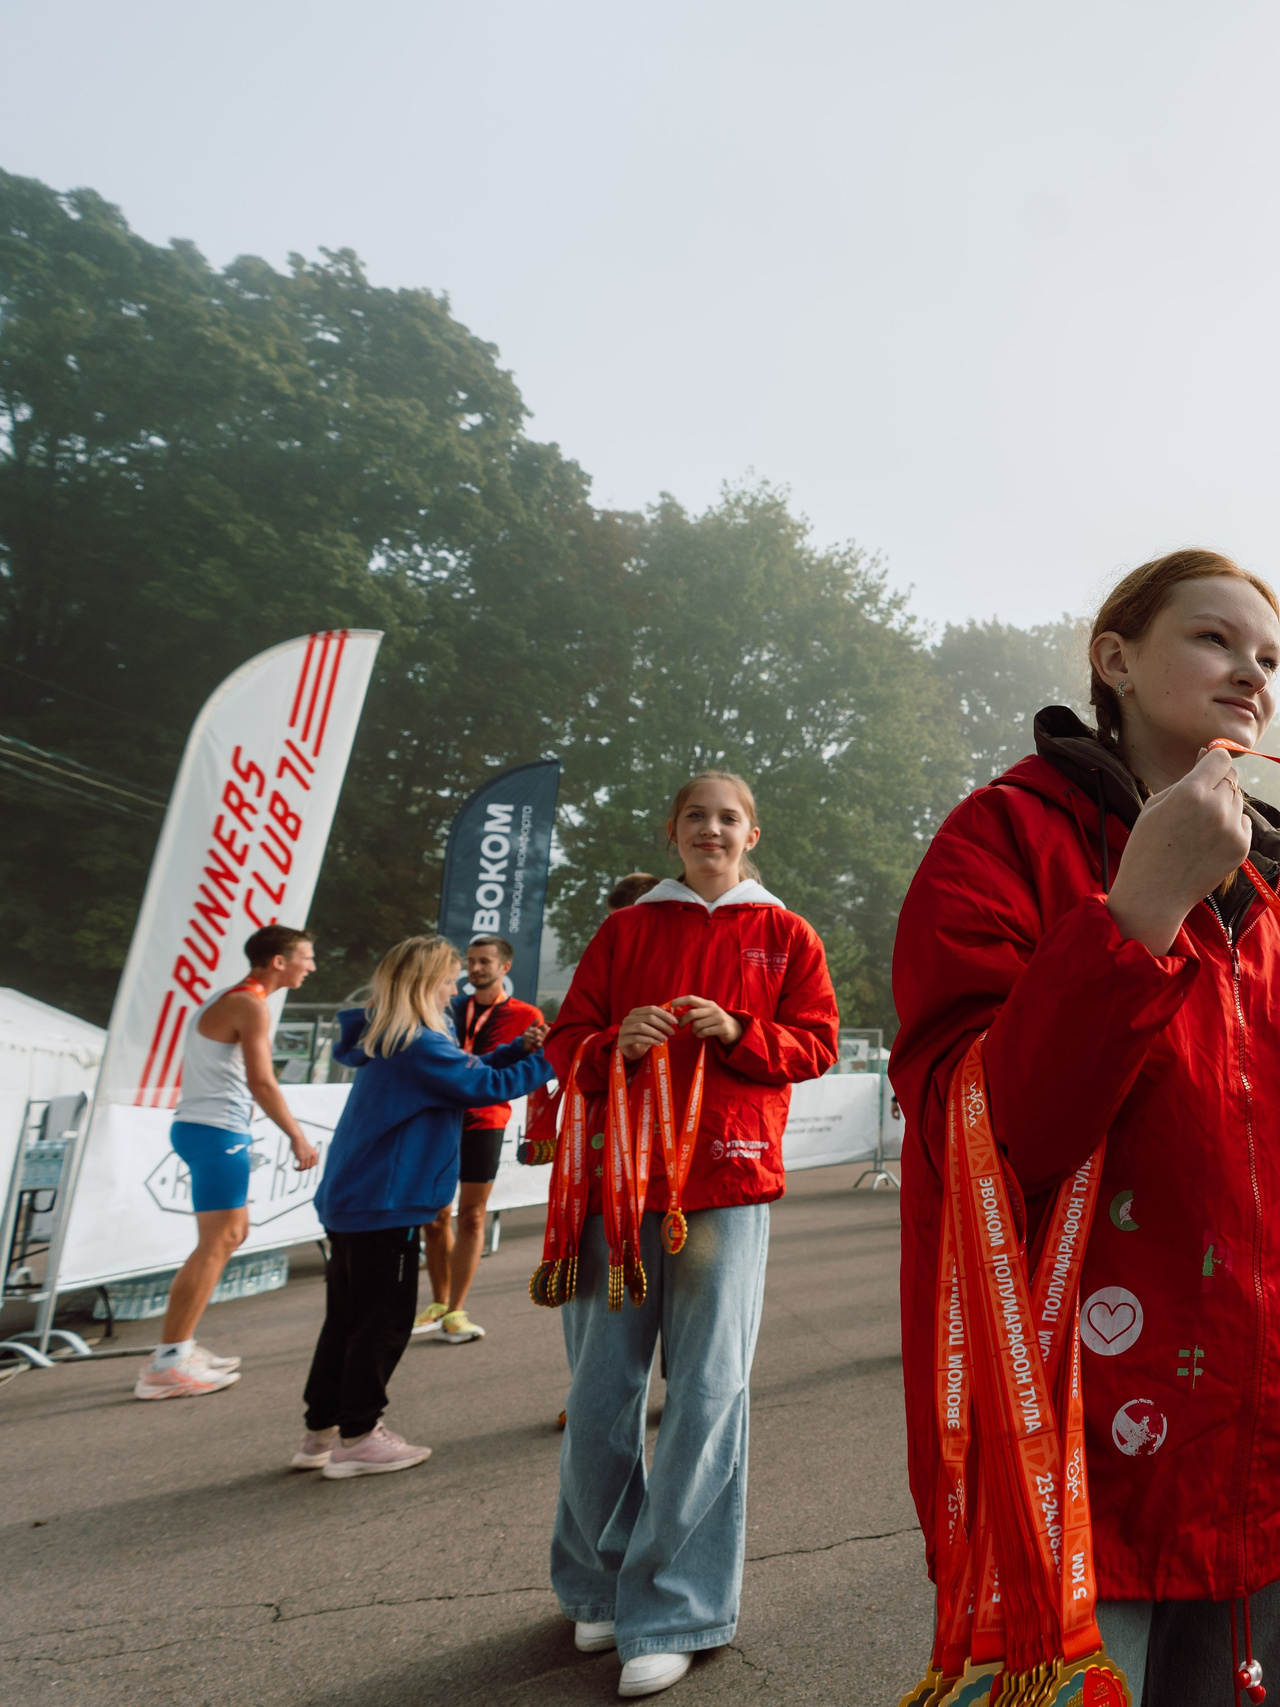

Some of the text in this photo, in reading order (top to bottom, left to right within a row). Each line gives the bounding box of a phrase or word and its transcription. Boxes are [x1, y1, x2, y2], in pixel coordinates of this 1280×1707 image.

[172, 745, 265, 1006] RUNNERS
[243, 790, 303, 928] CLUB
[979, 1176, 1042, 1434] ЭВОКОМ ПОЛУМАРАФОН ТУЛА
[1042, 1196, 1084, 1322] ПОЛУМАРАФОН
[947, 1354, 964, 1430] ЭВОКОМ
[1071, 1551, 1087, 1600] 5 КМ
